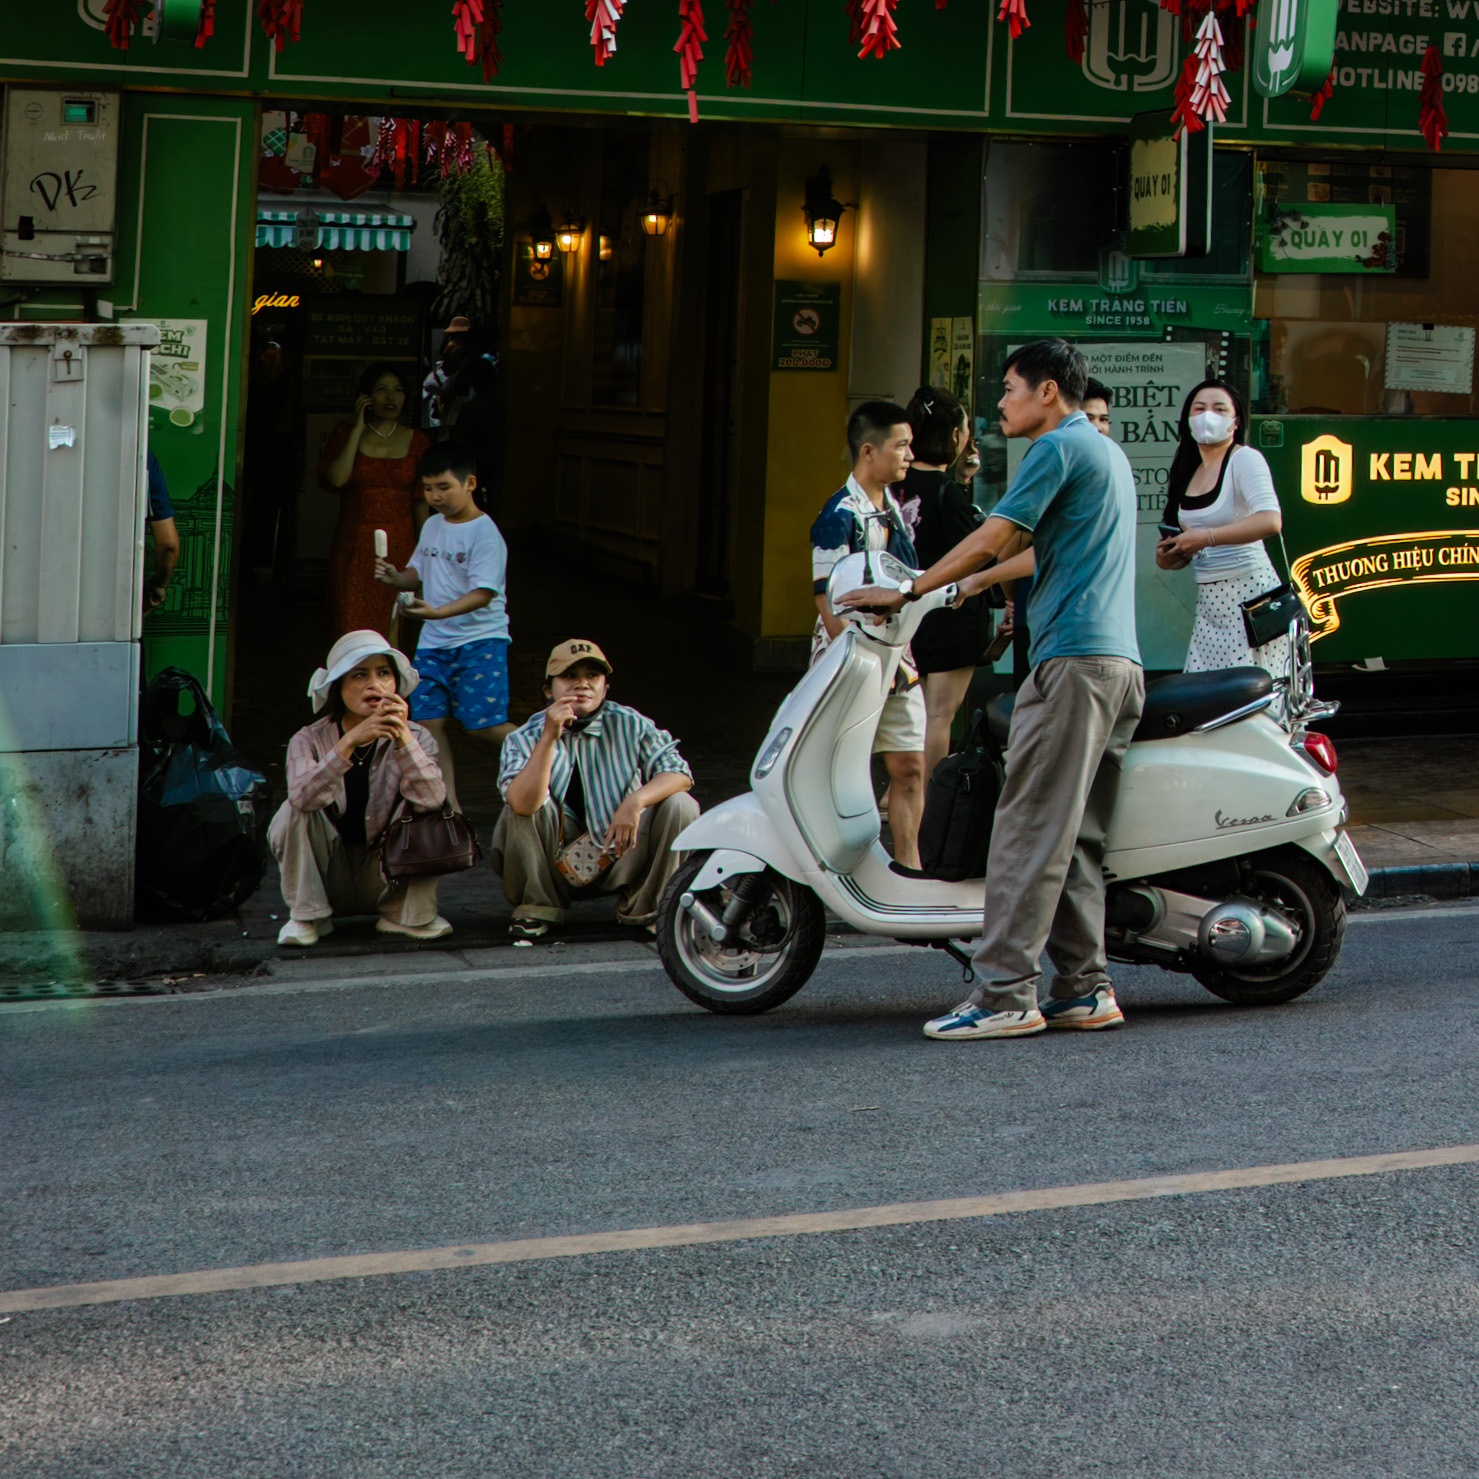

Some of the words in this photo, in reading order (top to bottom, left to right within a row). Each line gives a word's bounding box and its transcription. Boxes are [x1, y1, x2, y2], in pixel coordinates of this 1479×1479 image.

[1334, 30, 1430, 56] ANPAGE
[1350, 230, 1368, 248] 01
[251, 291, 301, 316] gian
[1048, 298, 1084, 313] KEM
[1085, 315, 1122, 326] SINCE
[1125, 315, 1151, 326] 1958
[159, 329, 184, 344] EM
[1112, 380, 1181, 413] BIỆT
[1369, 452, 1442, 481] KEM
[1214, 809, 1278, 831] Vespa
